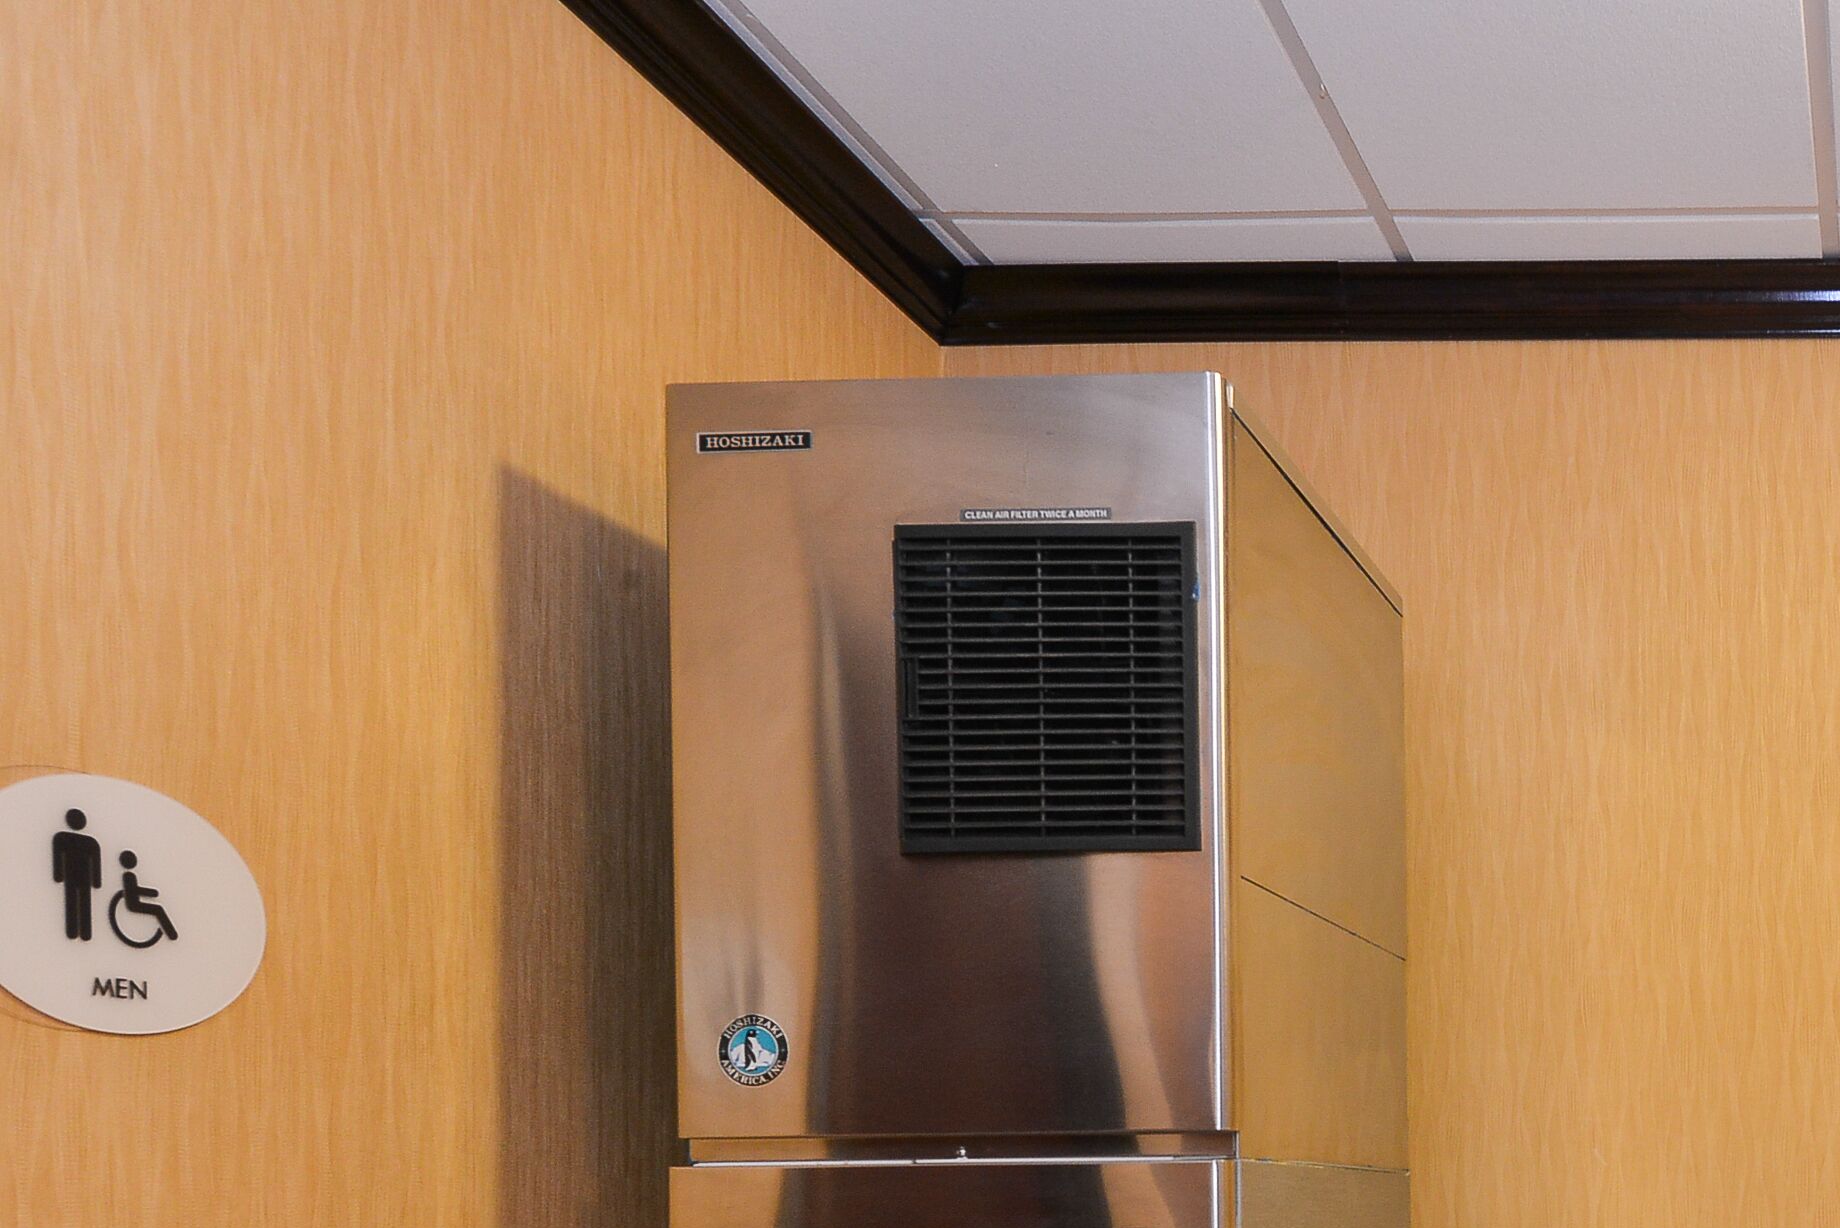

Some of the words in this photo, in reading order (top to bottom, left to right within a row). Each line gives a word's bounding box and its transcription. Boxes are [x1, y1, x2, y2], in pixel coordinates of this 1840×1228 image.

[705, 434, 804, 448] HOSHIZAKI
[964, 510, 994, 519] CLEAN
[994, 510, 1009, 519] AIR
[1010, 510, 1039, 519] FILTER
[1039, 509, 1067, 519] TWICE
[1075, 509, 1108, 518] MONTH
[92, 977, 148, 1000] MEN
[723, 1016, 784, 1039] HOSHIZAKI
